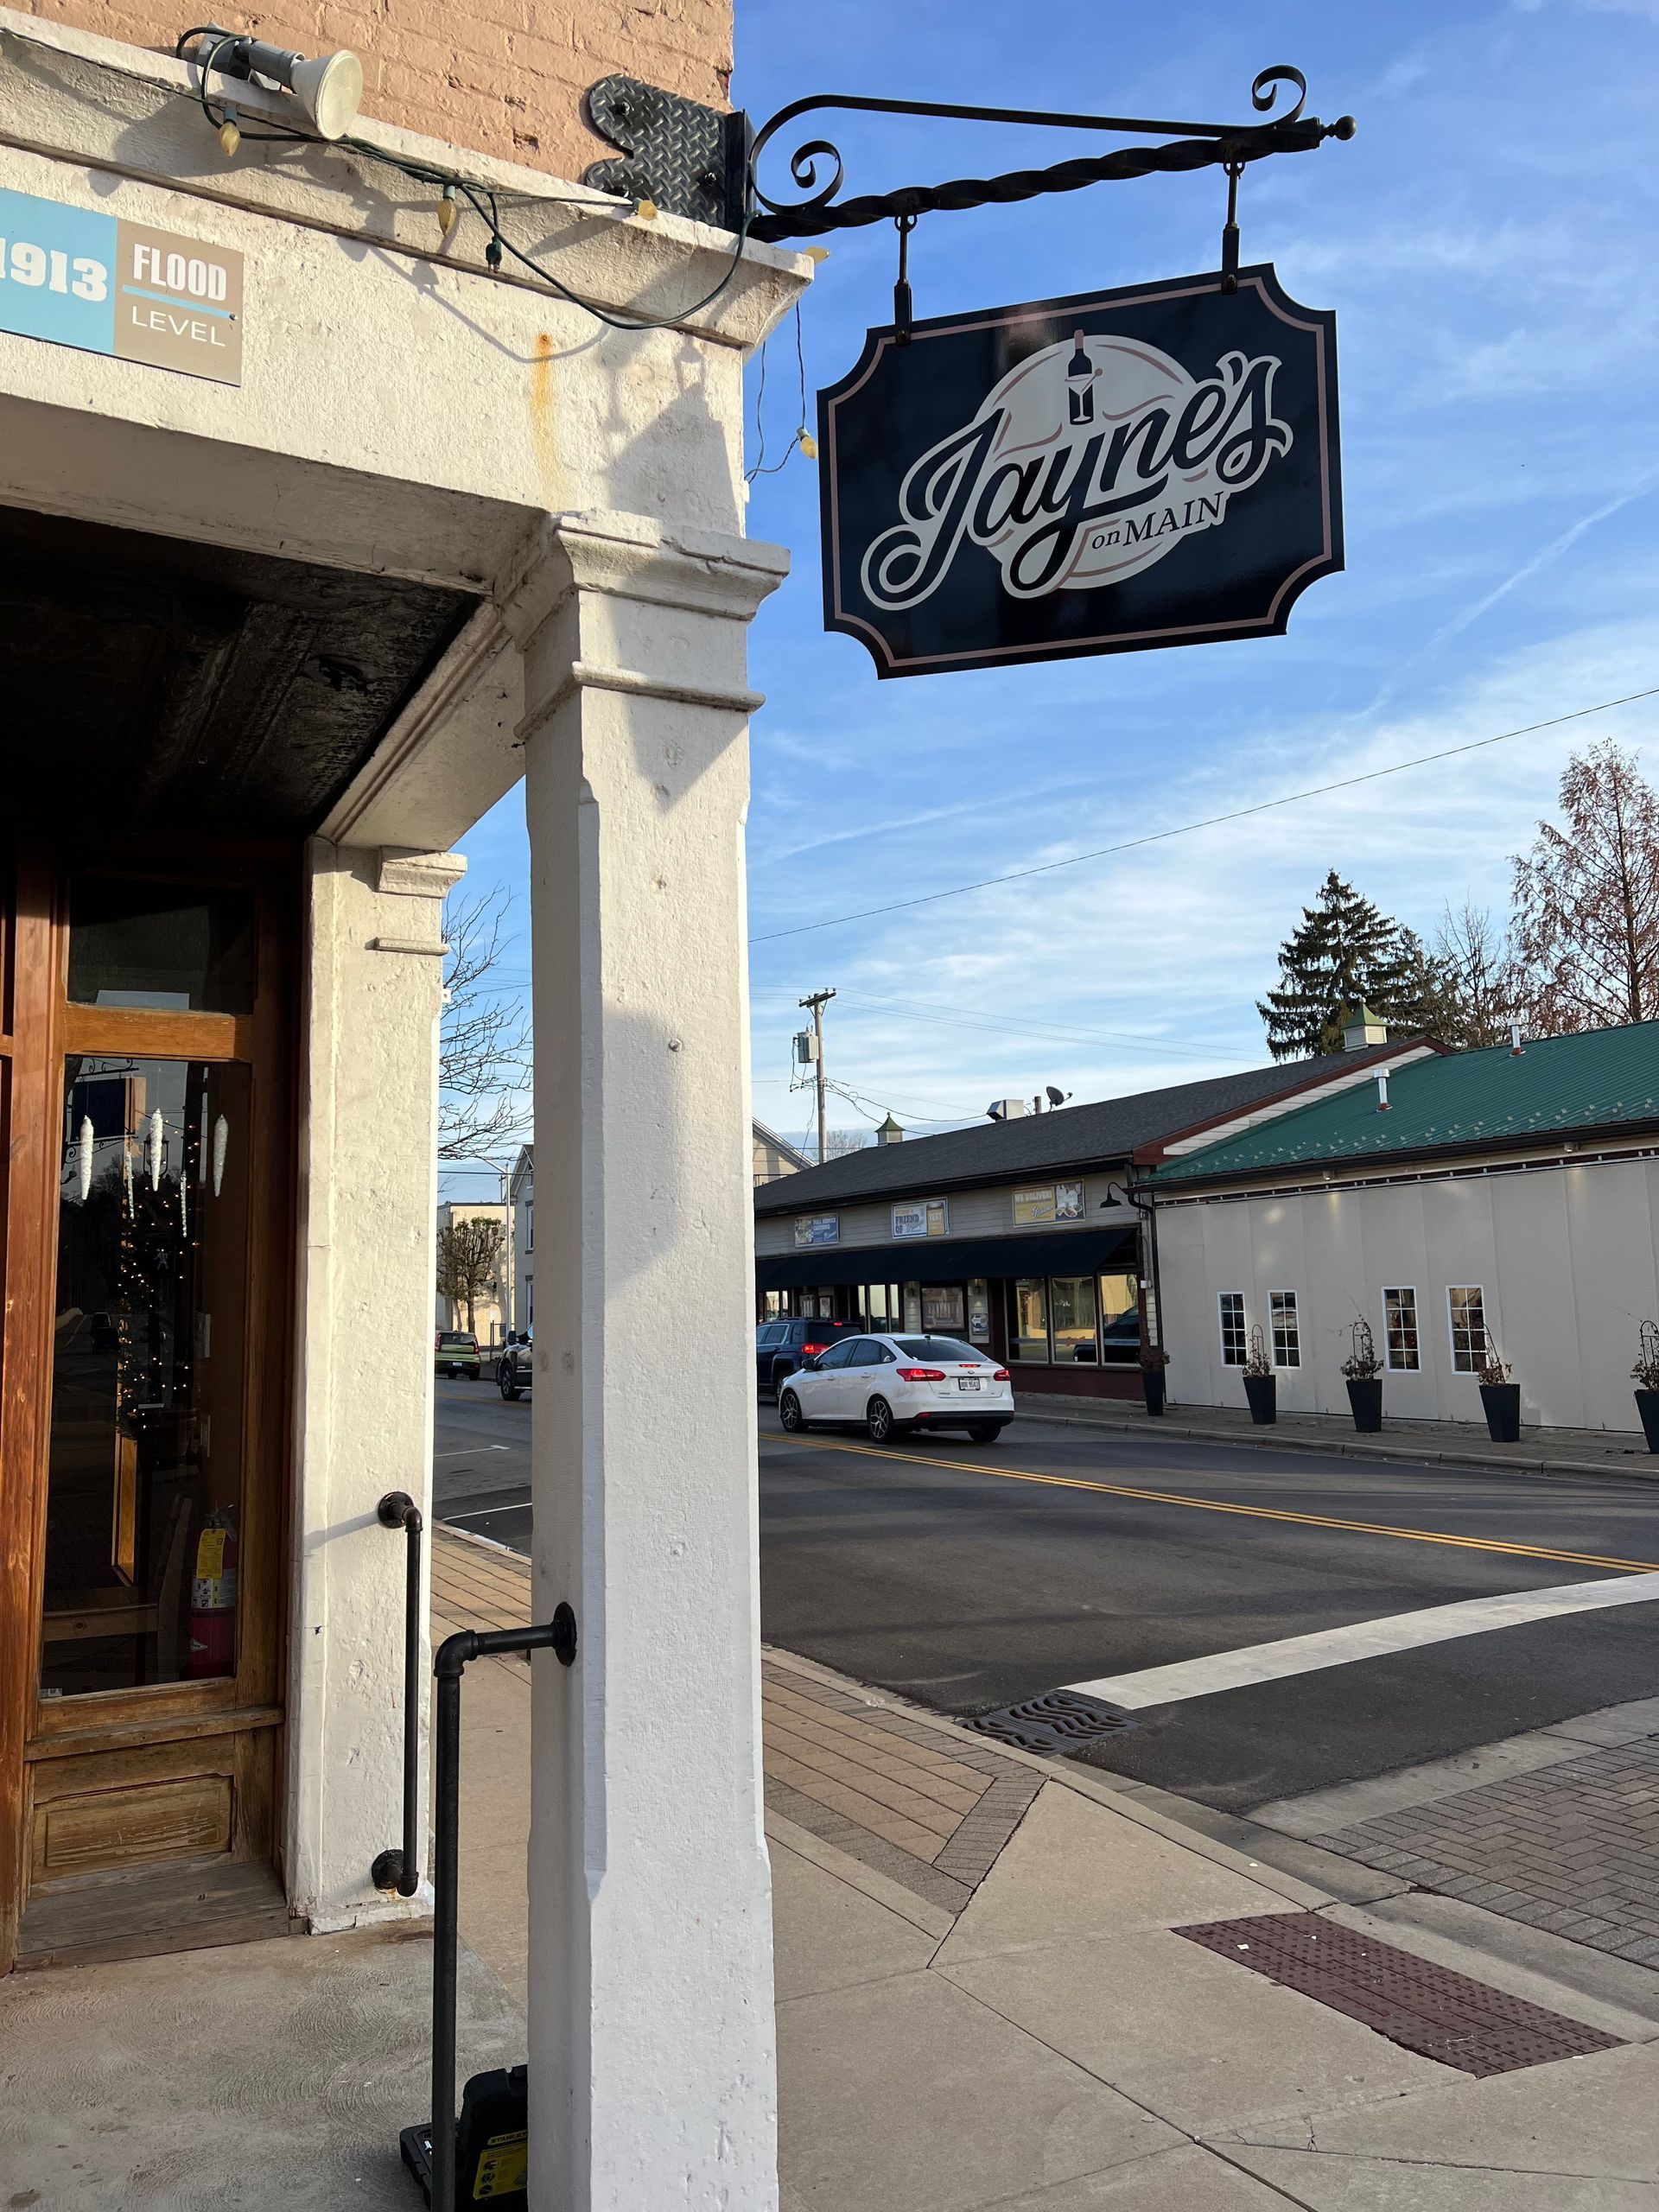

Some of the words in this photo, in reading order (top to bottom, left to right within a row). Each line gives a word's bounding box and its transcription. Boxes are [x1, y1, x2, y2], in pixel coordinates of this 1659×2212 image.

[133, 243, 226, 301] FLOOD
[132, 306, 226, 346] LEVEL
[865, 353, 1291, 607] Jayne's
[1091, 521, 1121, 550] on
[1123, 491, 1226, 547] MAIN
[894, 1214, 919, 1225] FRIEND
[895, 1225, 904, 1234] OF
